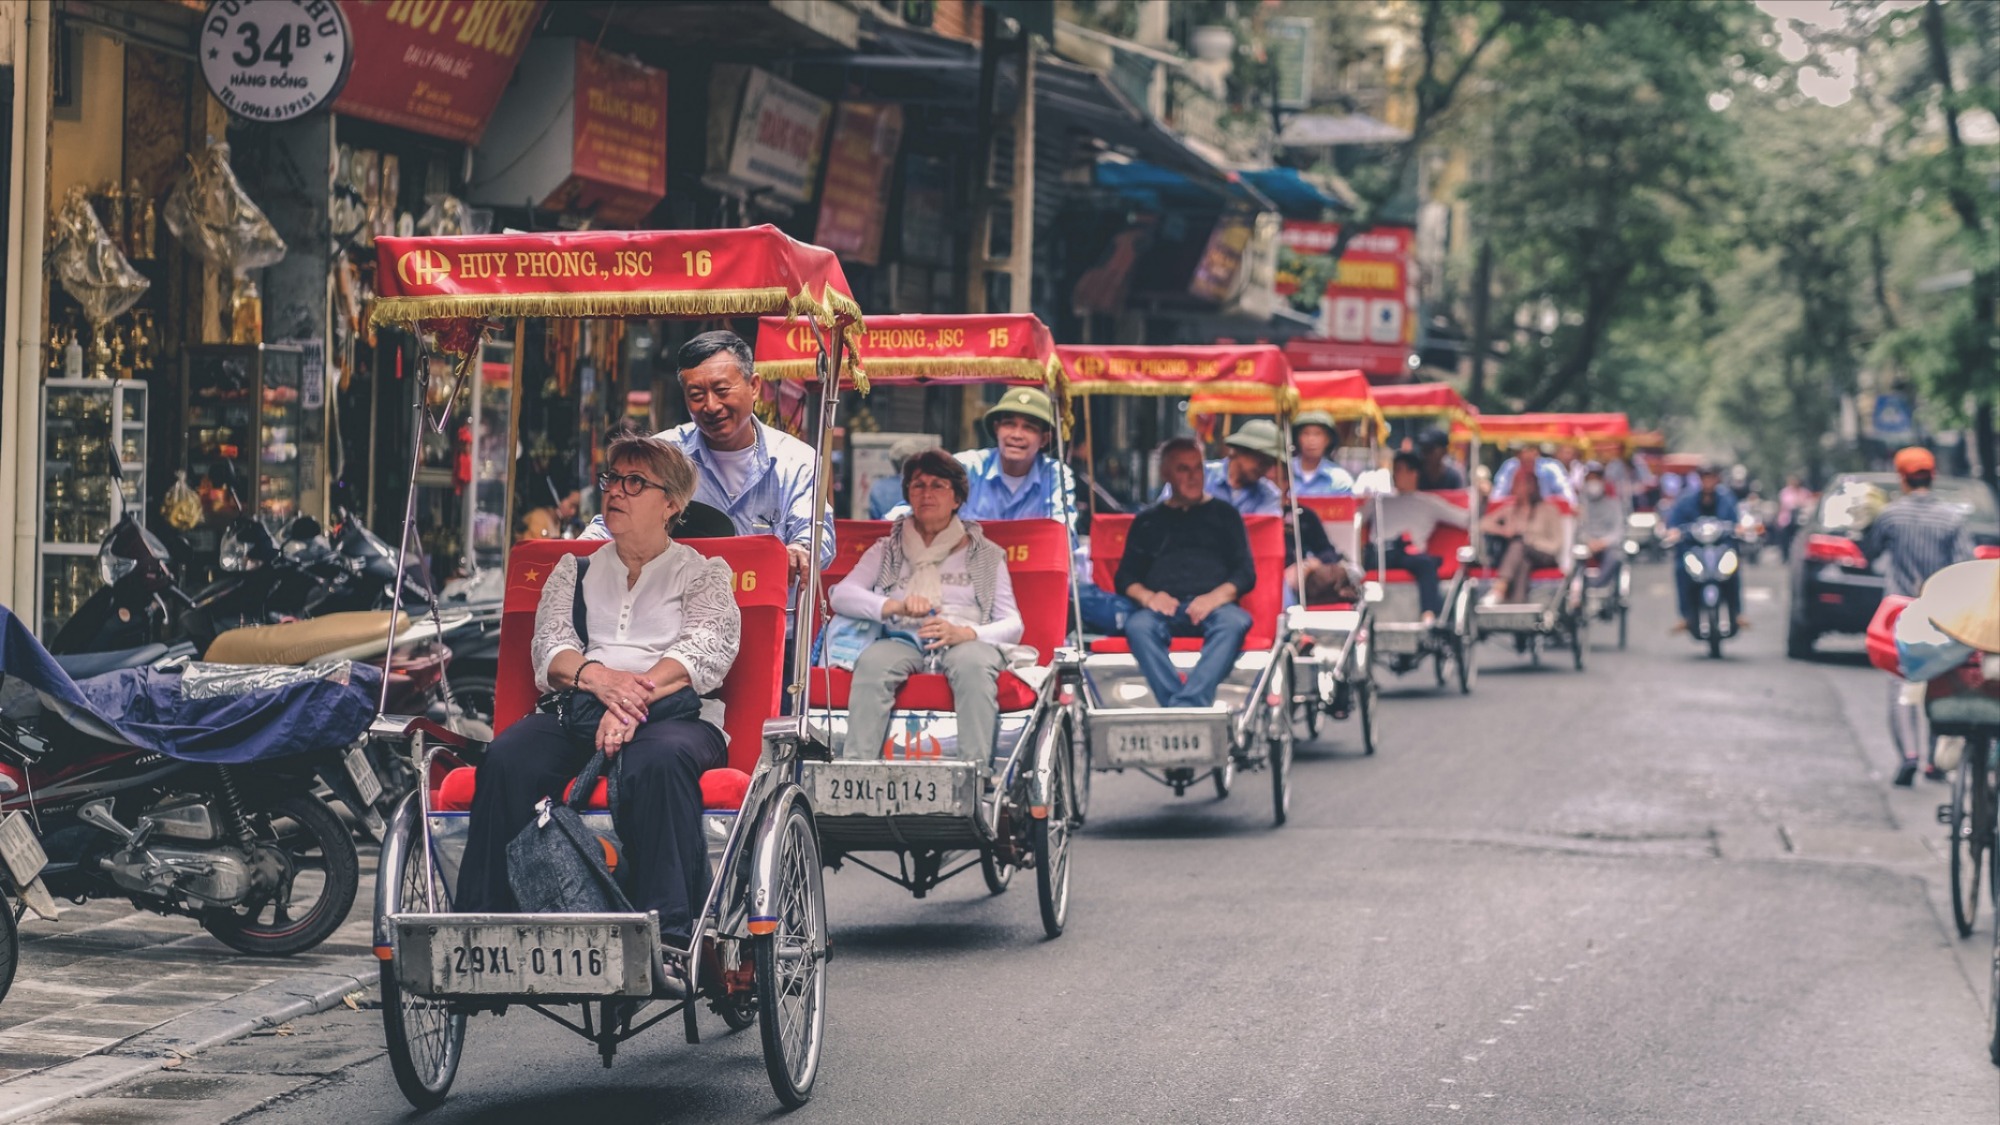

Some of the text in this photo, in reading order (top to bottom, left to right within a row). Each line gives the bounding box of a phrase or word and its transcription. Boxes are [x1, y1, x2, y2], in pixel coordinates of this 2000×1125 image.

[459, 253, 508, 278] HUY
[682, 250, 712, 277] 16
[988, 327, 1009, 348] 15
